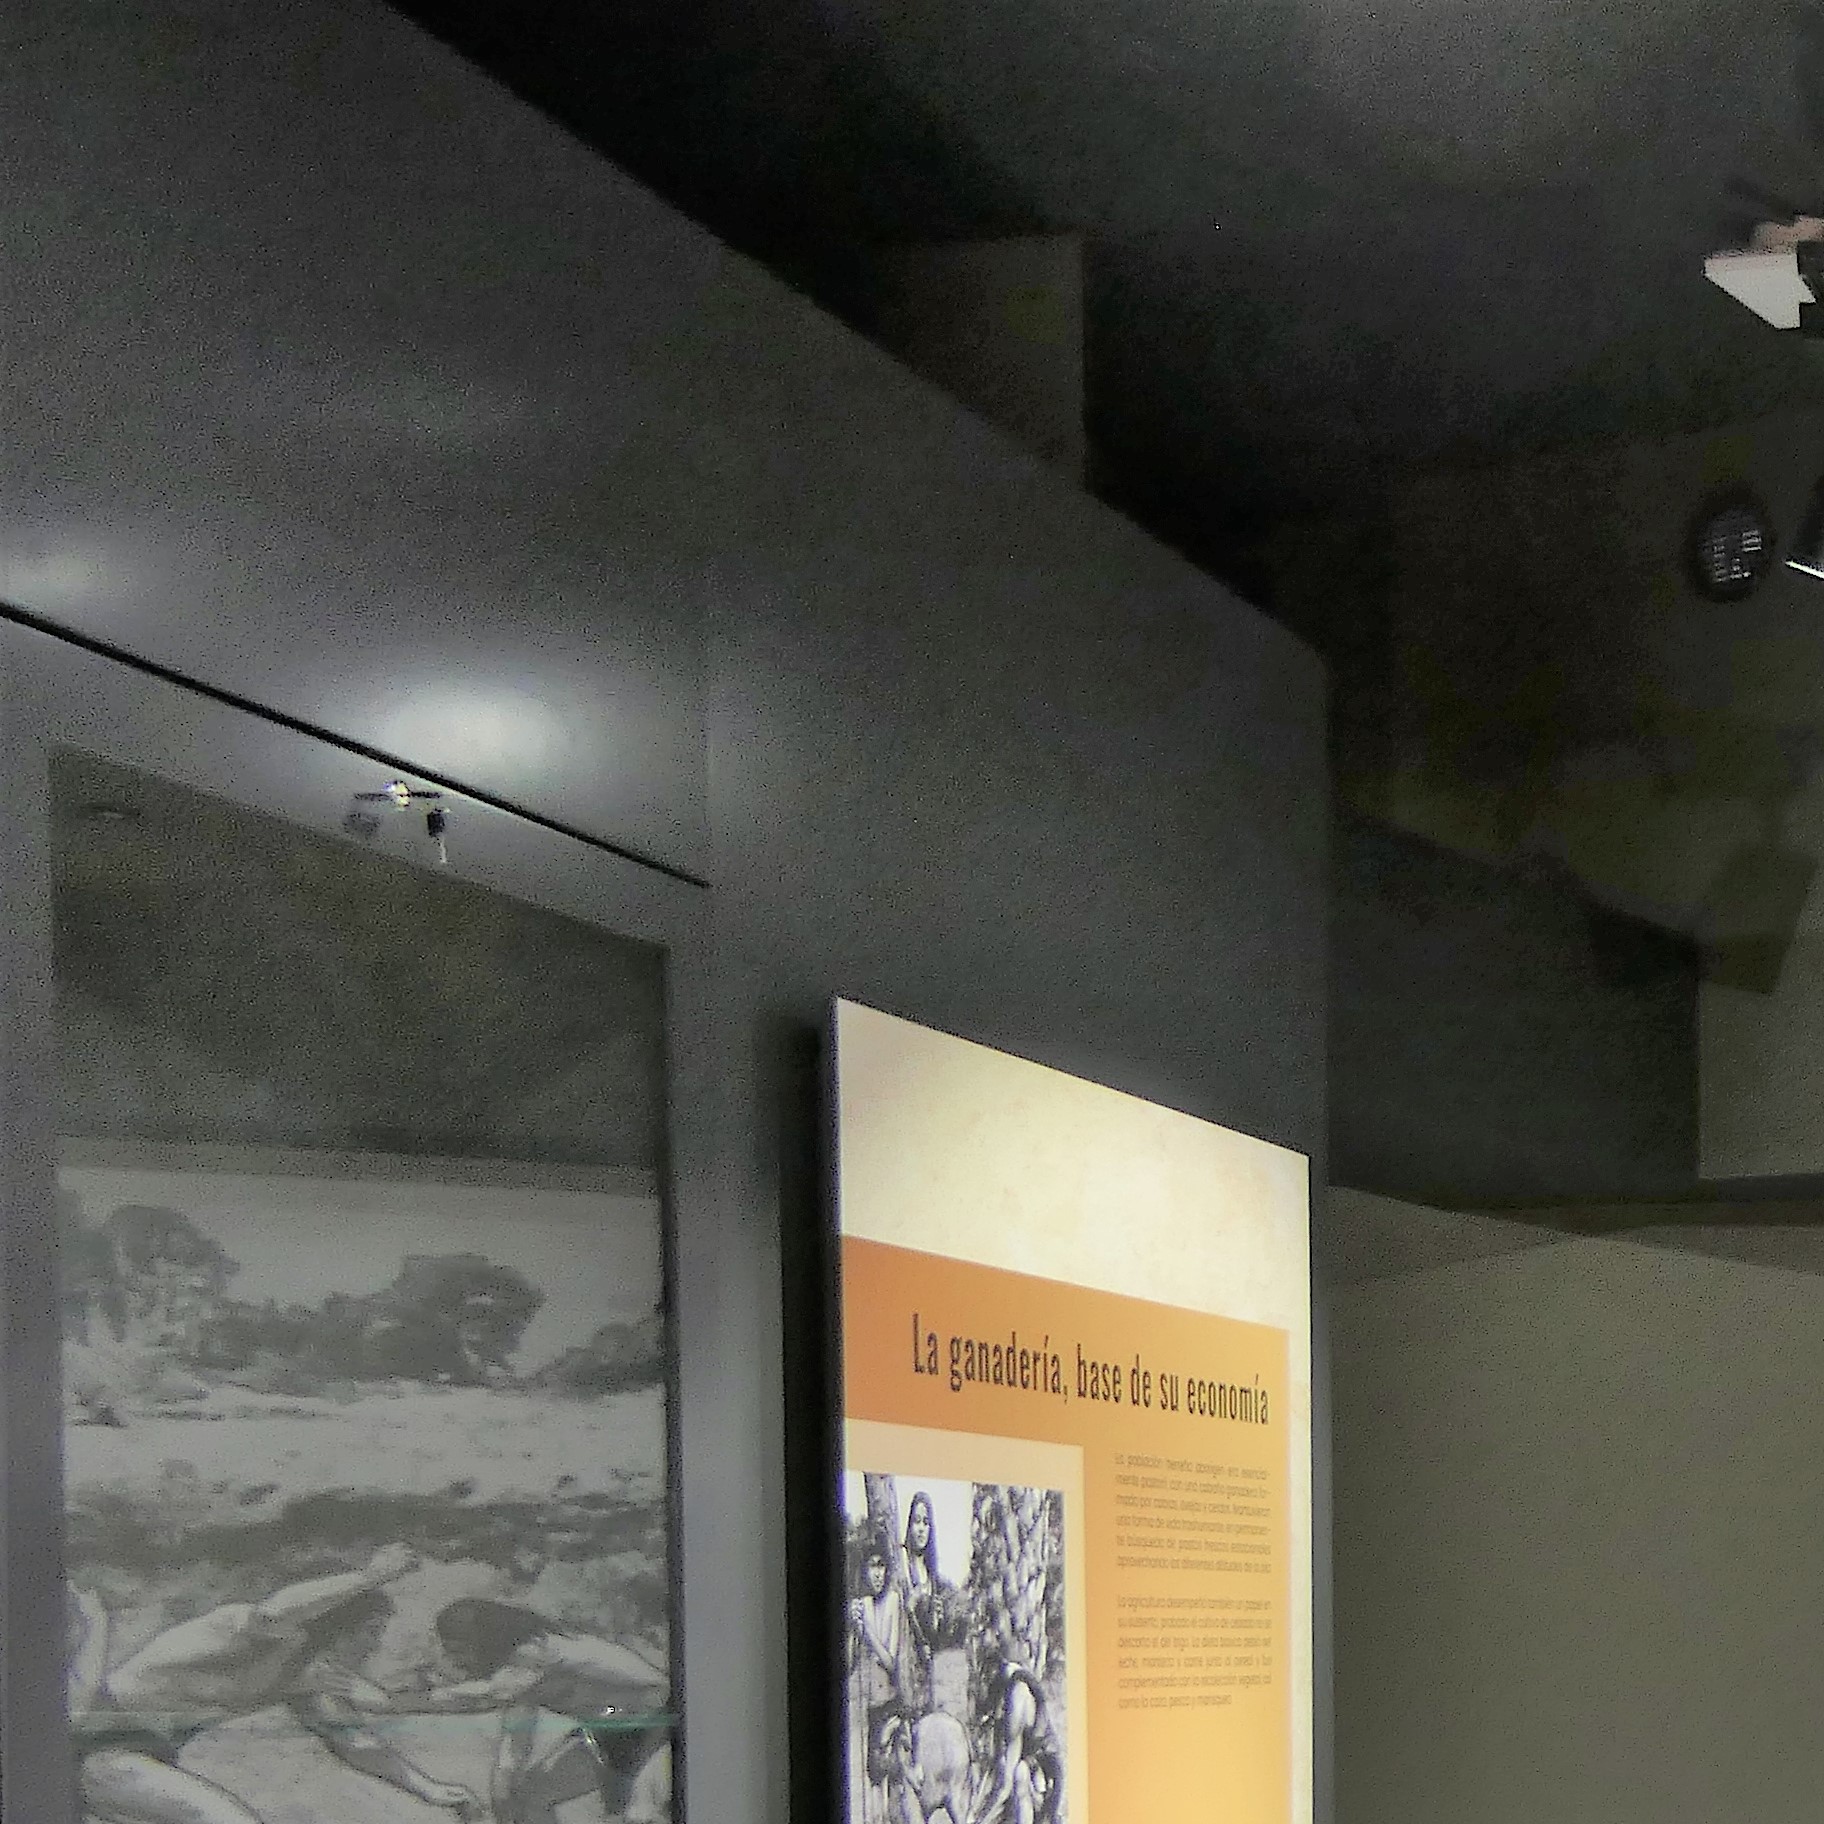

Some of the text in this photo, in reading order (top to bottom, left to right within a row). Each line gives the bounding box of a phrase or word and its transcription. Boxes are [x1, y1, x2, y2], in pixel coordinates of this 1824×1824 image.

[912, 1313, 1269, 1425] La ganadería, base de su economía
